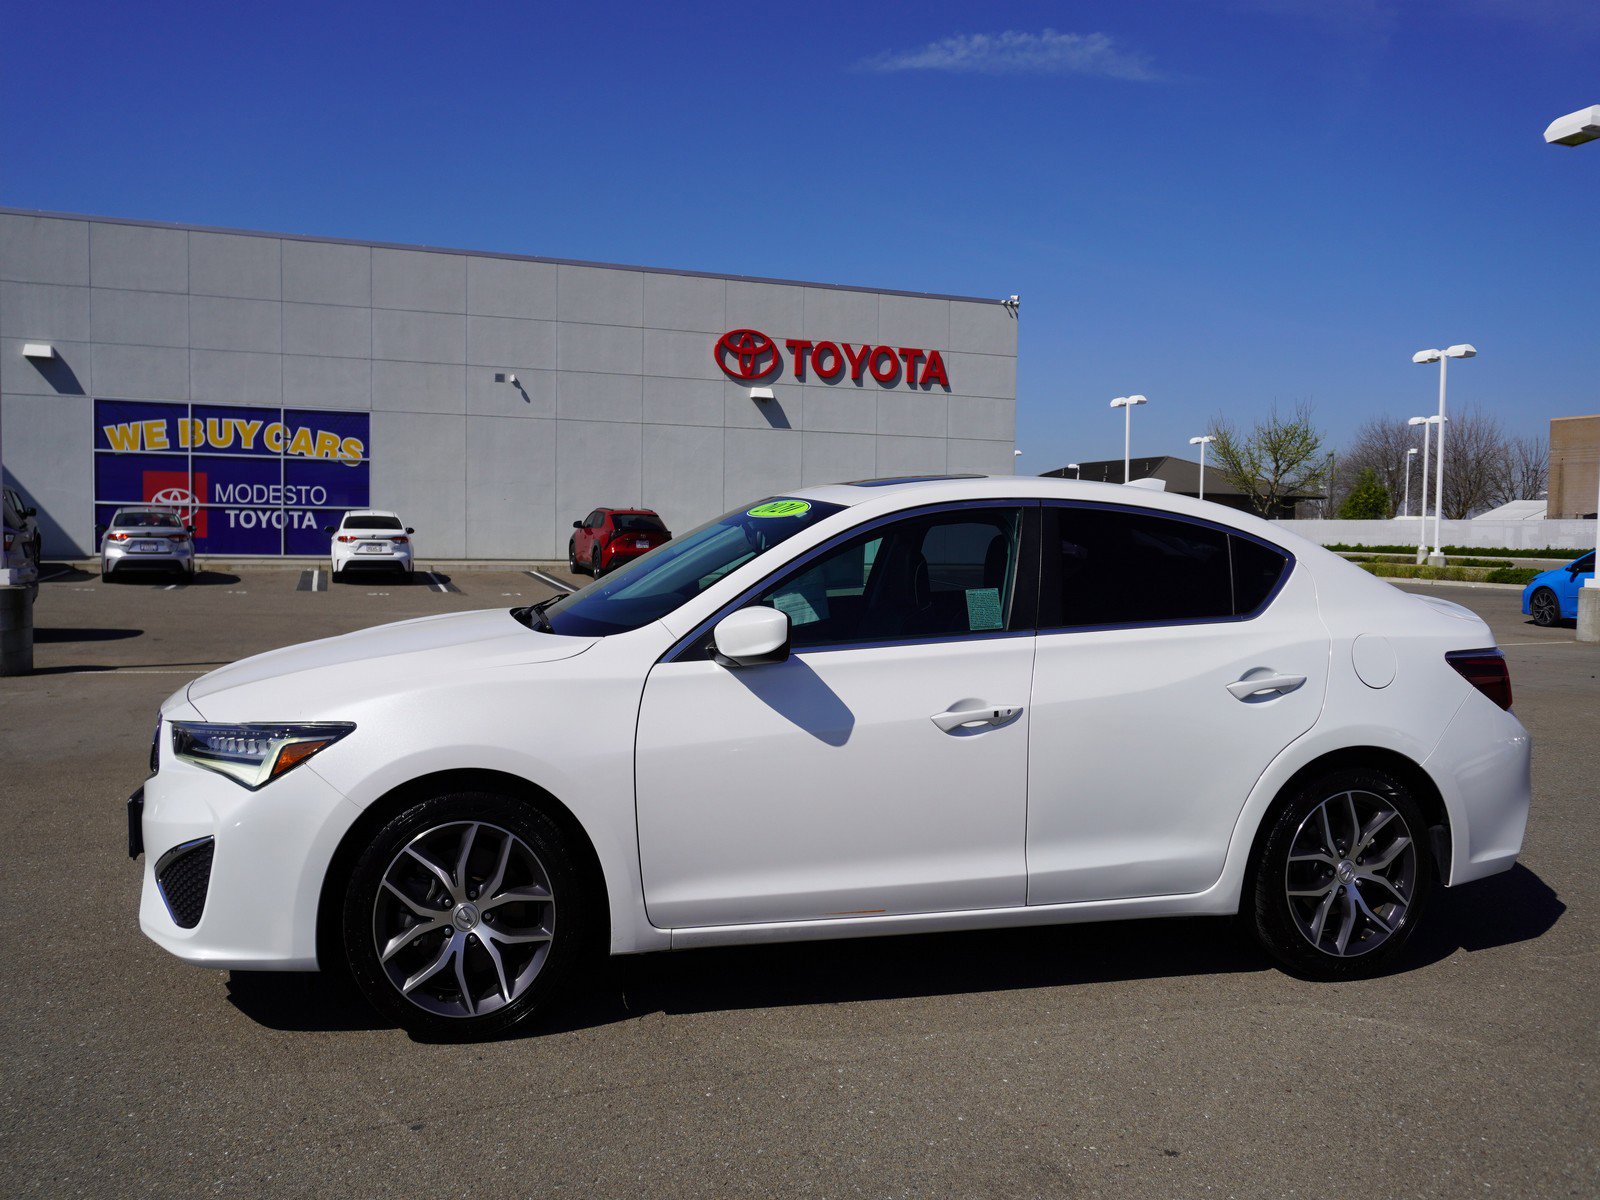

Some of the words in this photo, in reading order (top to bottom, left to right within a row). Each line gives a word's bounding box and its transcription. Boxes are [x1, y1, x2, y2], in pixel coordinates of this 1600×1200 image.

[786, 339, 949, 386] TOYOTA
[103, 419, 170, 452] WE
[178, 418, 263, 450] BUY
[263, 422, 365, 467] CARS
[215, 483, 327, 505] MODESTO
[225, 509, 318, 530] TOYOTA
